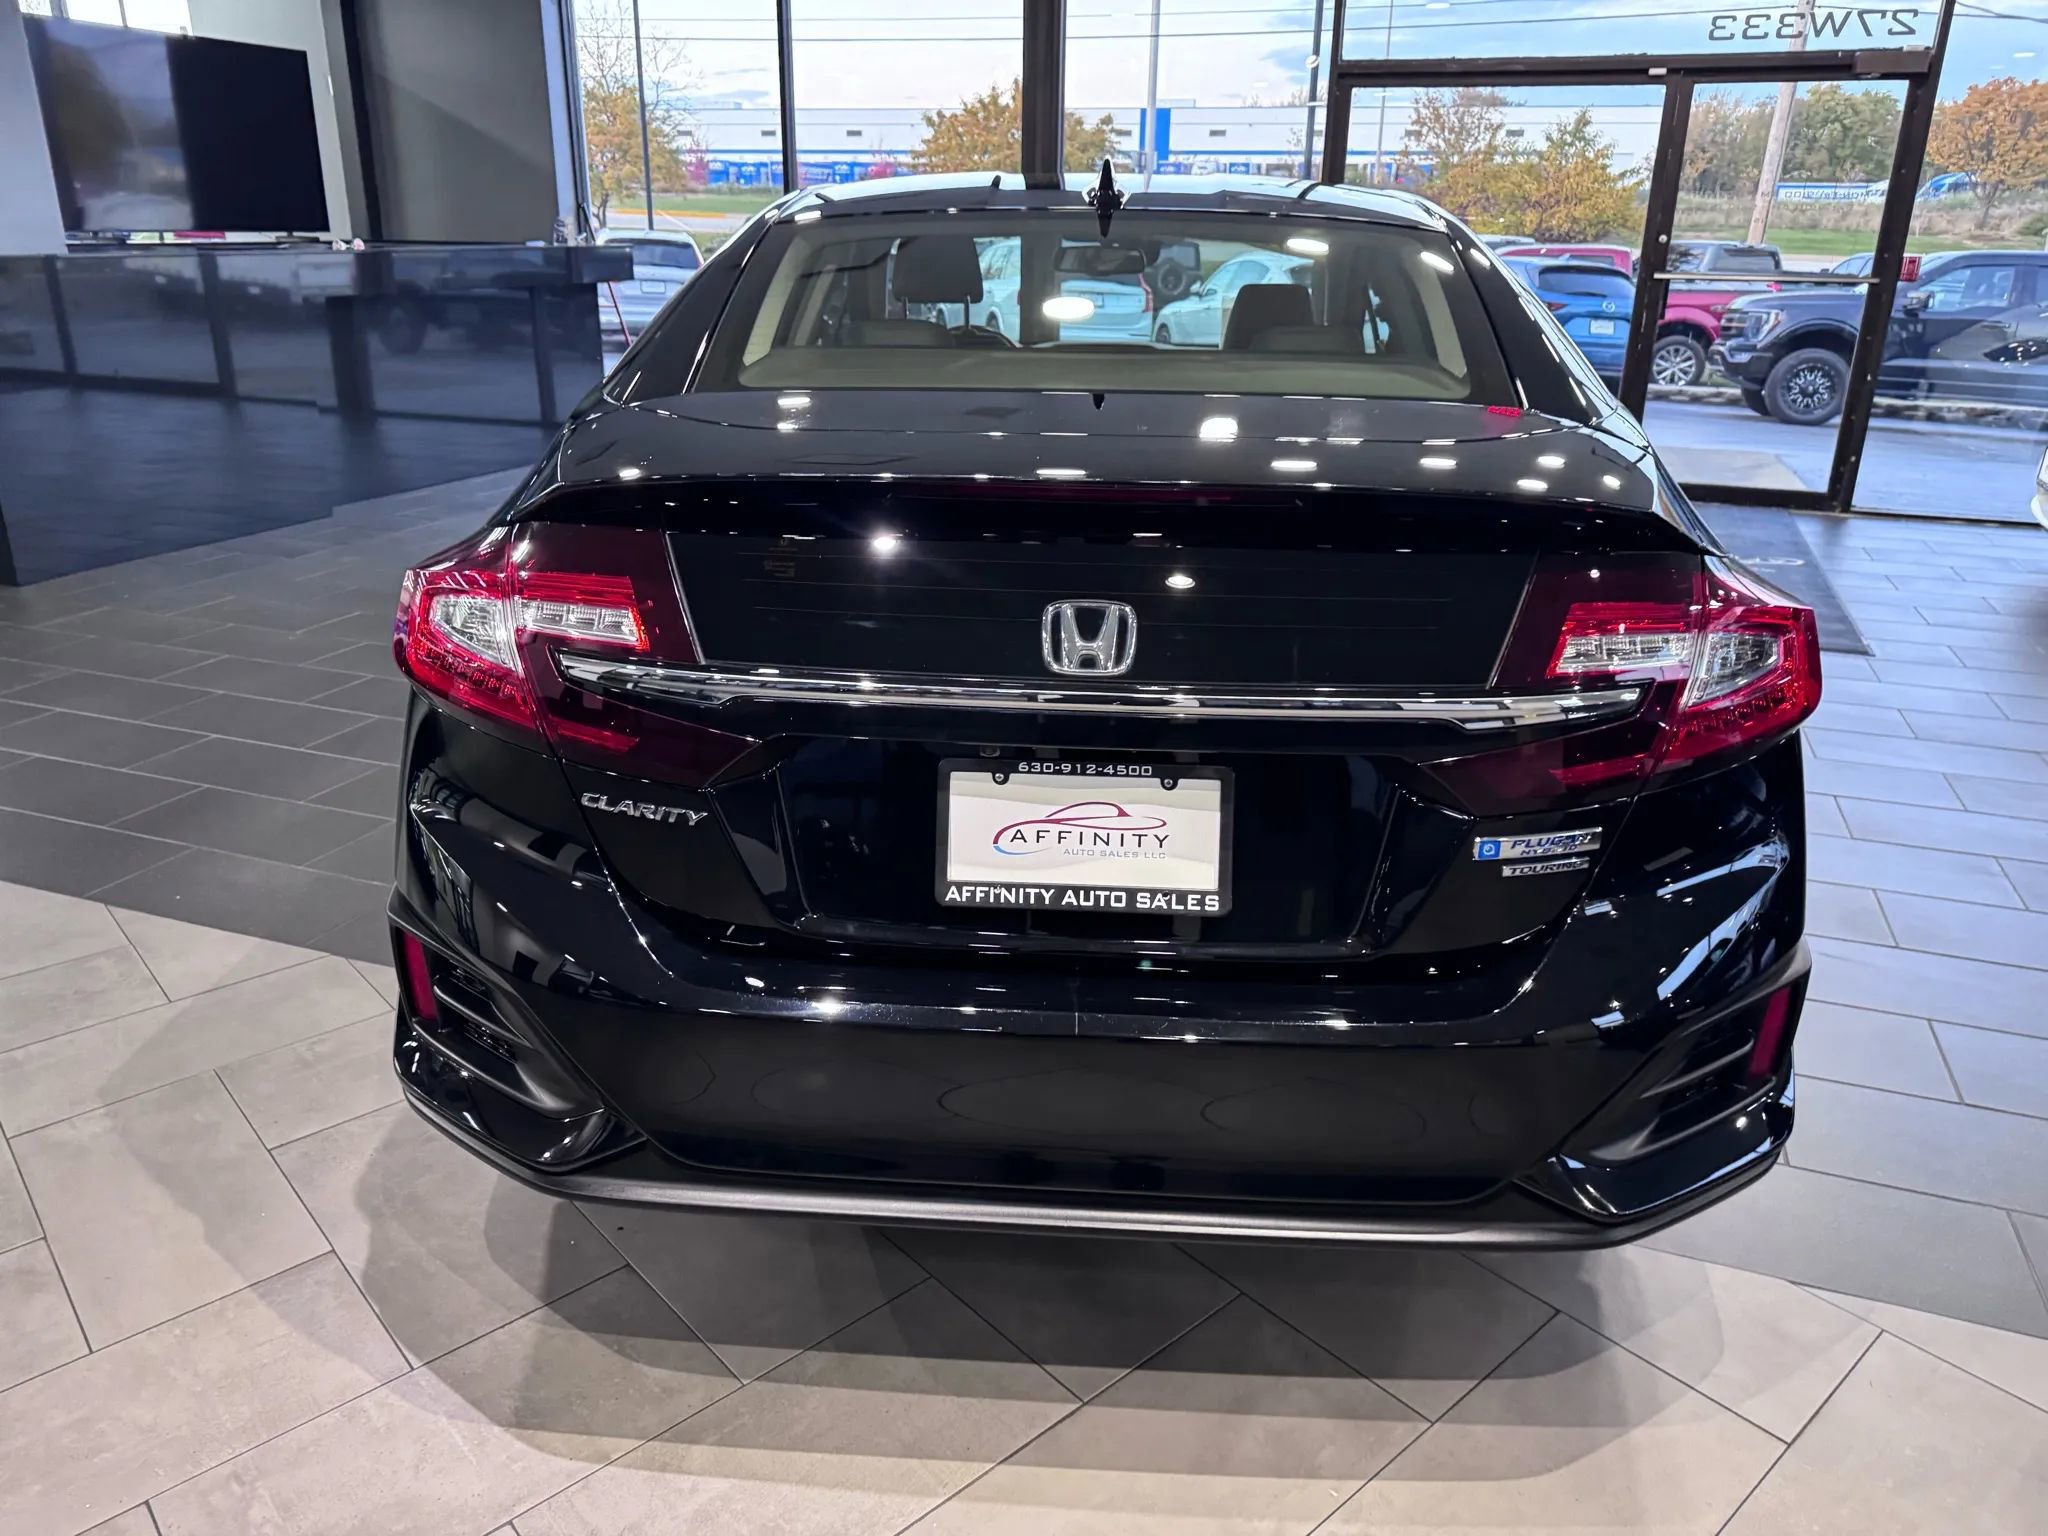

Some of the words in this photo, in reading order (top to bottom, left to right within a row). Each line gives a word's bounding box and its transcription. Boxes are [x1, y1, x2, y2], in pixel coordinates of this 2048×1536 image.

[1018, 762, 1153, 776] 630-912-4500
[580, 792, 709, 826] CLARITY
[1010, 829, 1170, 849] AFFINITY
[1063, 848, 1095, 856] AUTO
[1100, 850, 1139, 858] SALES
[1509, 861, 1584, 875] TOURING
[945, 884, 1055, 905] AFFINITY
[1061, 889, 1127, 908] AUTO
[1136, 892, 1220, 912] SALES
